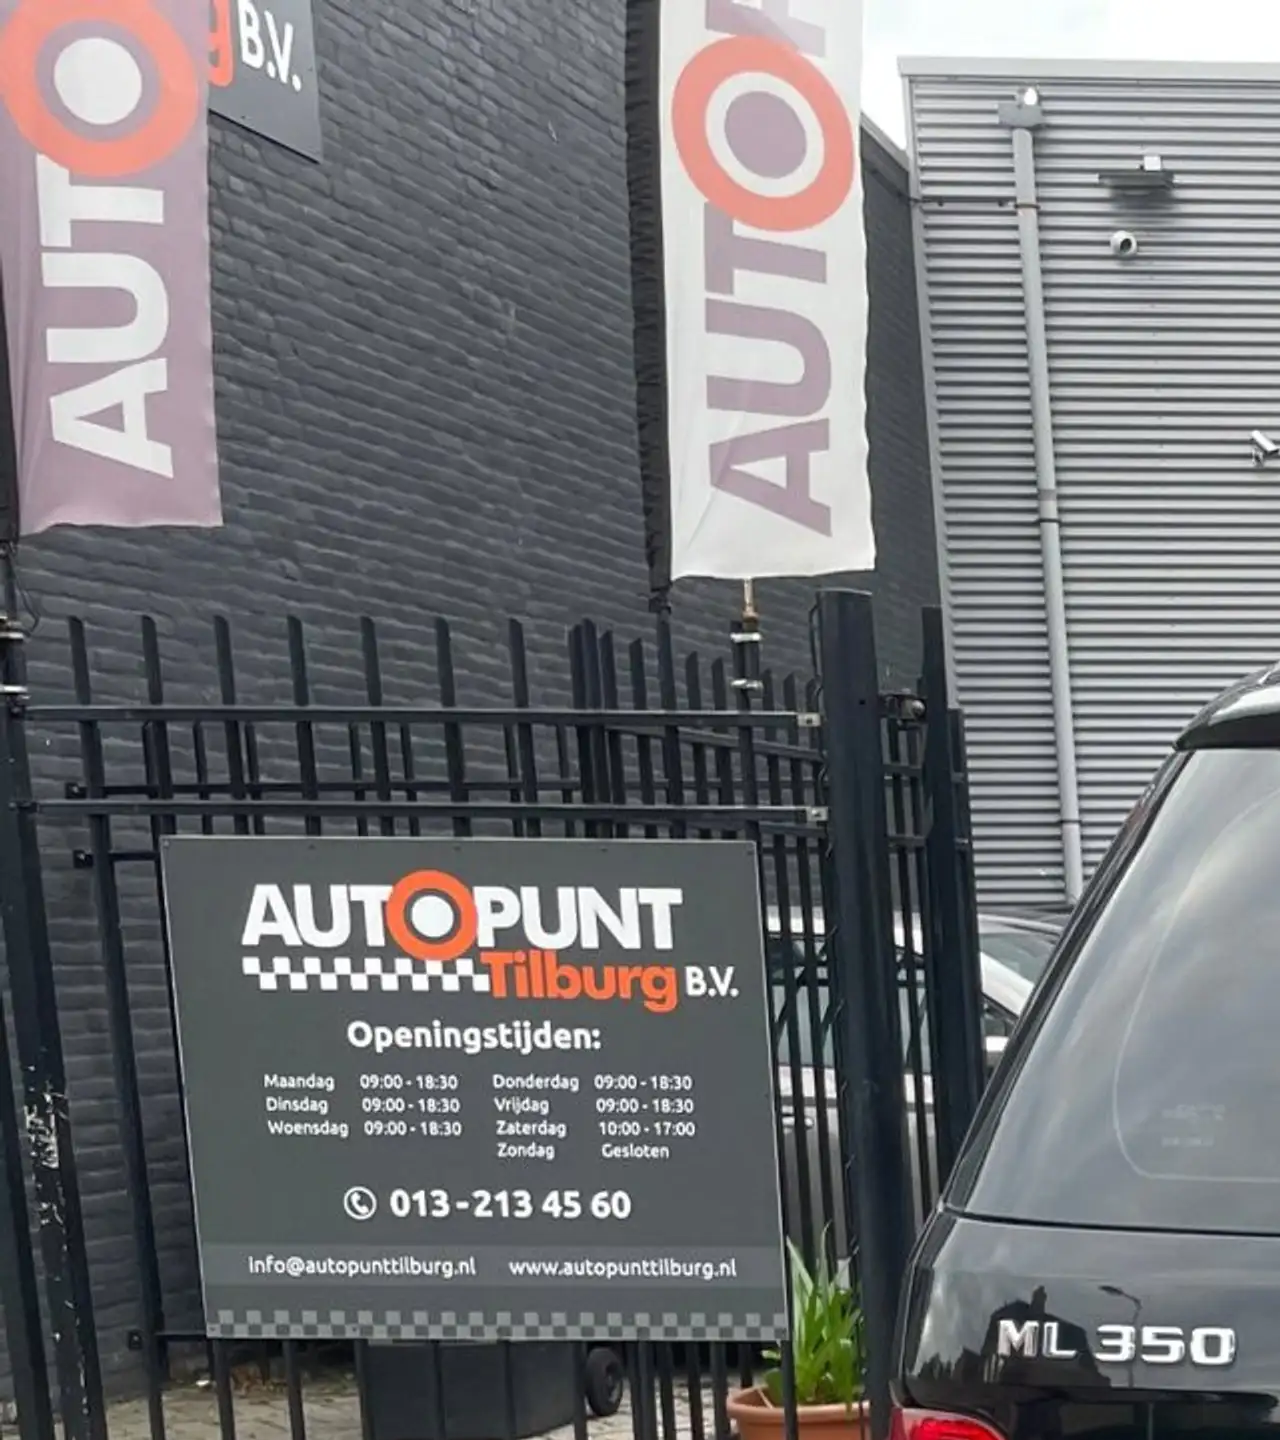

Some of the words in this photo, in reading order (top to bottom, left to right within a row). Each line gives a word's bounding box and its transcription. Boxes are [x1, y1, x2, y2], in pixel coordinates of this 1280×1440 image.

[238, 0, 302, 92] B.V.
[242, 870, 682, 960] AUTOPUNT
[479, 949, 679, 1013] Tilburg
[685, 965, 739, 997] B.V.
[347, 1019, 601, 1055] Openingstijden:
[264, 1073, 335, 1092] Maandag
[359, 1074, 403, 1090] 09:00
[416, 1074, 458, 1090] 18:30
[492, 1073, 580, 1092] Donderdag
[594, 1074, 637, 1090] 09:00
[651, 1075, 693, 1091] 18:30
[266, 1096, 329, 1115] Dinsdag
[361, 1097, 405, 1113] 09:00
[417, 1097, 461, 1113] 18:30
[494, 1096, 549, 1115] Vrijdag
[595, 1097, 639, 1113] 09:00
[652, 1098, 694, 1114] 18:30
[267, 1119, 349, 1138] Woensdag
[364, 1120, 407, 1136] 09:00
[420, 1120, 462, 1136] 18:30
[496, 1119, 567, 1138] Zaterdag
[599, 1121, 641, 1136] 10:00
[653, 1121, 695, 1136] 17:00
[497, 1141, 555, 1160] Zondag
[601, 1143, 670, 1159] Gesloten
[541, 1190, 582, 1219] 45
[590, 1190, 632, 1219] 60
[248, 1255, 476, 1279] info@autopunttilburg.nl
[508, 1258, 737, 1280] www.autopunttilburg.nl
[998, 1319, 1077, 1358] ML
[1094, 1324, 1236, 1365] 350
